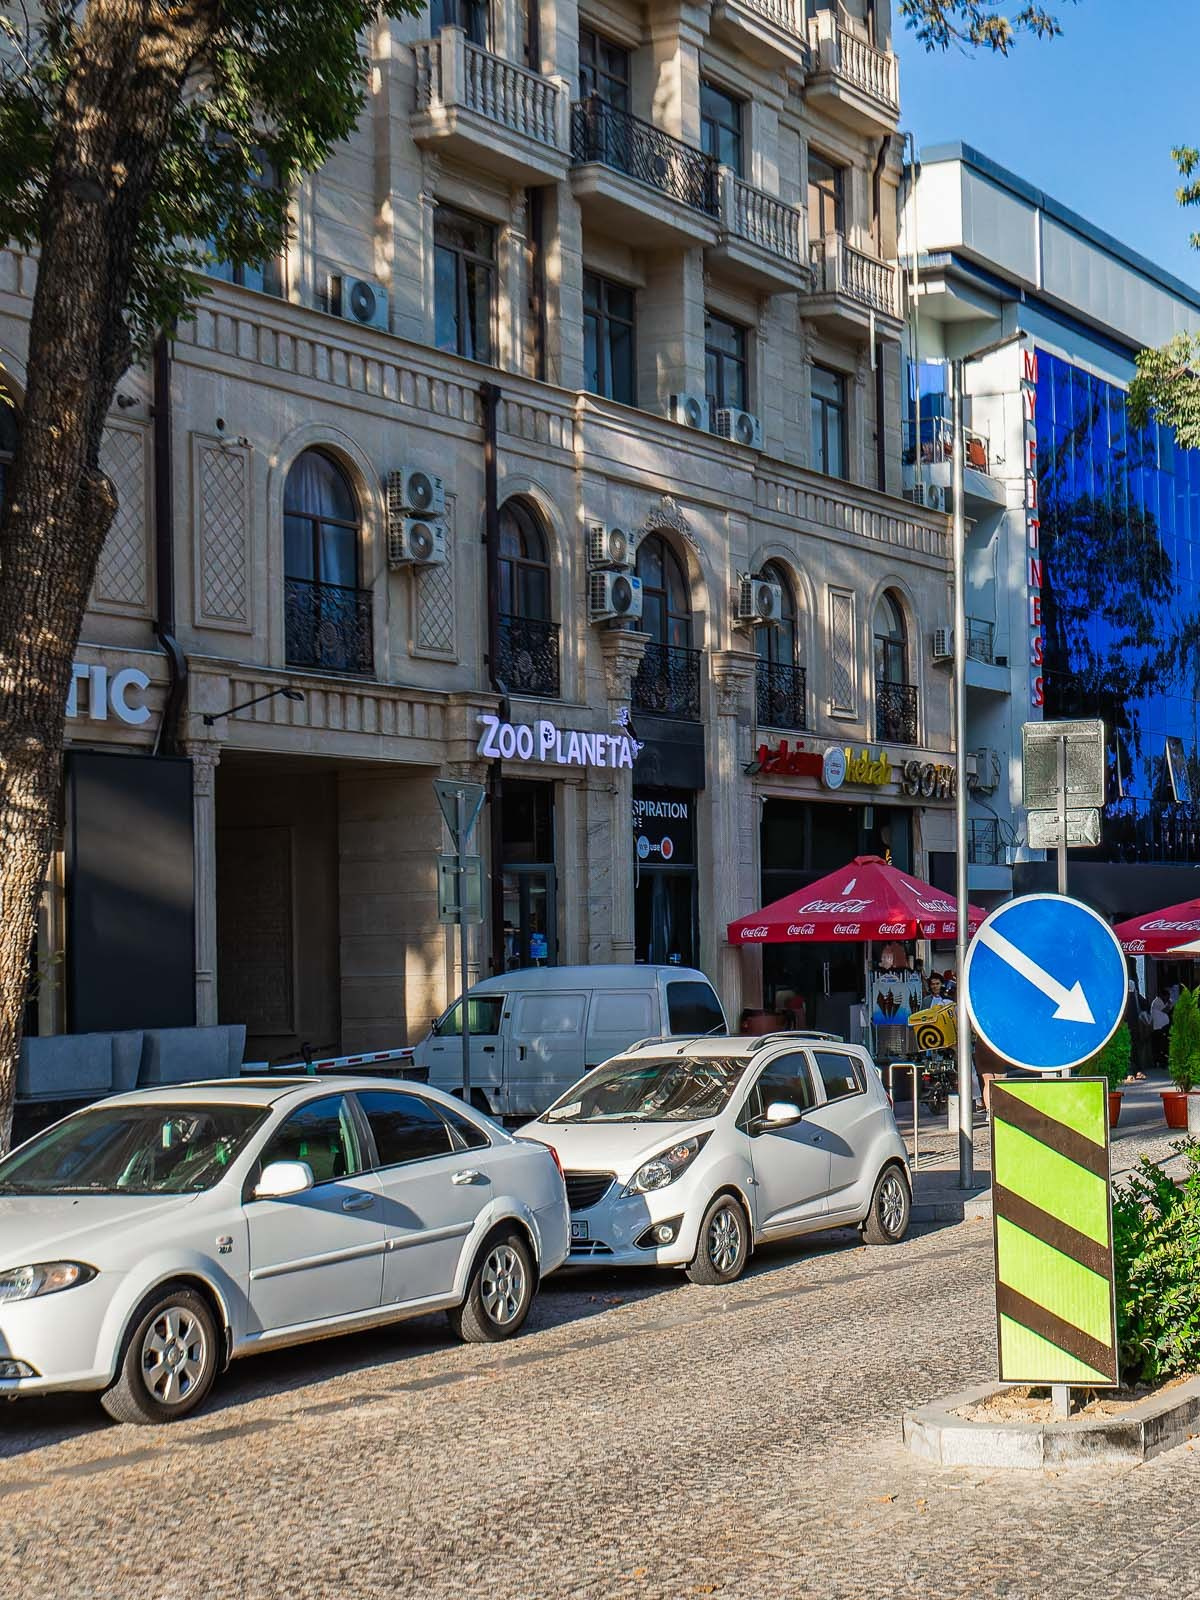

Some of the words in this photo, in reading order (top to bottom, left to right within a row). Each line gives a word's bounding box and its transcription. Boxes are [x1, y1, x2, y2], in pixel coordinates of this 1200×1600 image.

[1022, 349, 1038, 421] MY
[1026, 440, 1044, 708] FITNESS
[537, 720, 634, 768] PLANETA
